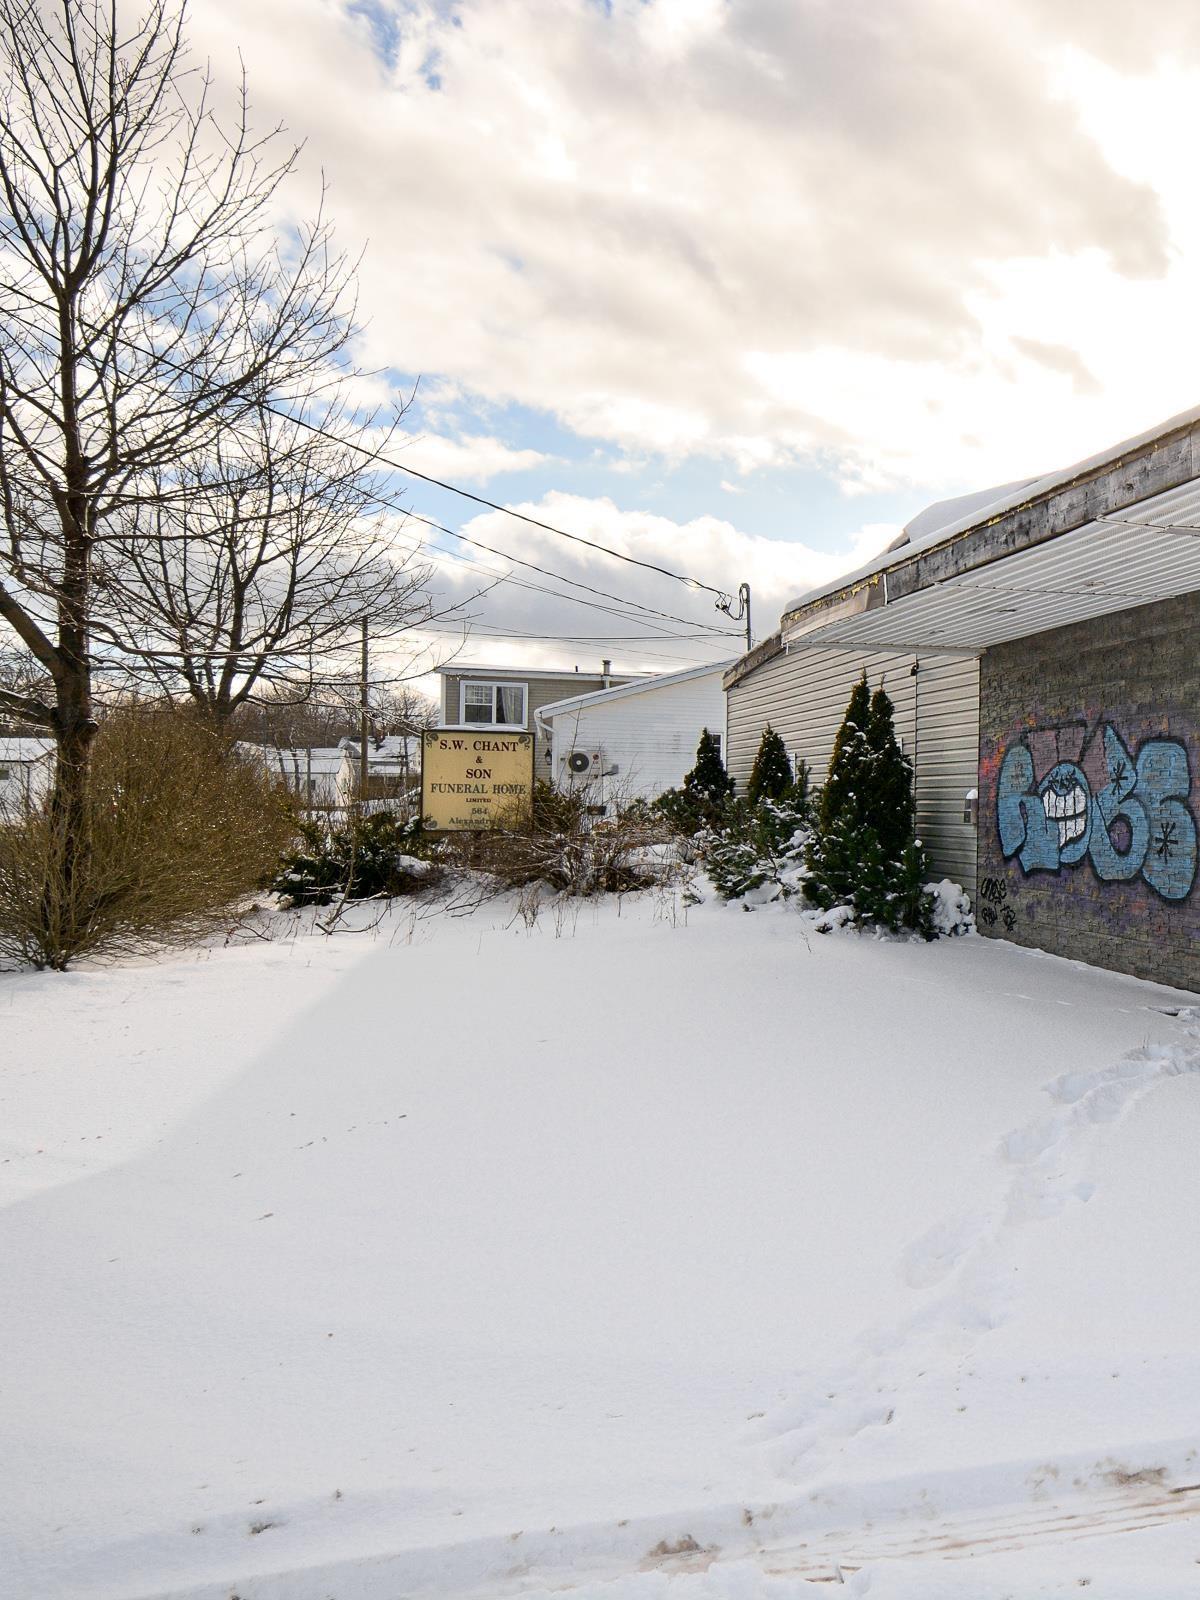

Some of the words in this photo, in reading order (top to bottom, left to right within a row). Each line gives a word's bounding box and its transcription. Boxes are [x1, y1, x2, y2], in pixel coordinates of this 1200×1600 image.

[439, 740, 468, 750] S.W.
[473, 740, 519, 752] CHANT
[475, 755, 483, 764] &
[465, 768, 492, 779] SON
[430, 783, 488, 794] FUNERAL
[492, 784, 526, 795] HOME
